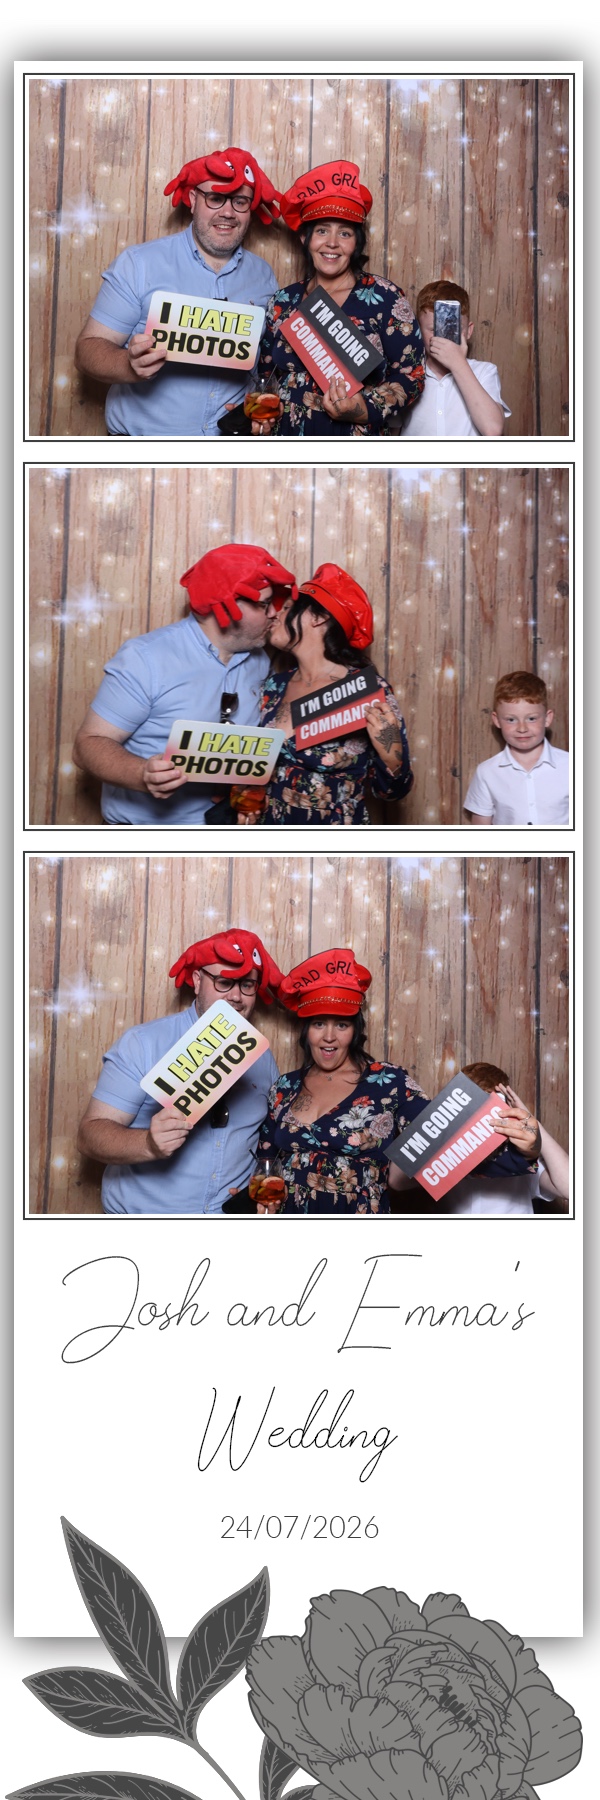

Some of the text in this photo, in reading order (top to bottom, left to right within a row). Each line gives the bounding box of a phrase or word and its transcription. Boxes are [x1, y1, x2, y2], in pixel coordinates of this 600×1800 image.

[331, 173, 358, 190] GRL
[160, 302, 254, 336] I HATE
[309, 299, 370, 367] I'M GOING
[151, 329, 252, 360] PHOTOS
[300, 676, 367, 717] I'M GOING
[179, 730, 275, 756] I HATE
[171, 755, 269, 777] PHOTOS
[325, 961, 353, 976] GRL
[154, 1013, 237, 1096] I HATE
[173, 1031, 257, 1117] PHOTOS
[400, 1087, 473, 1163] I'M GOING
